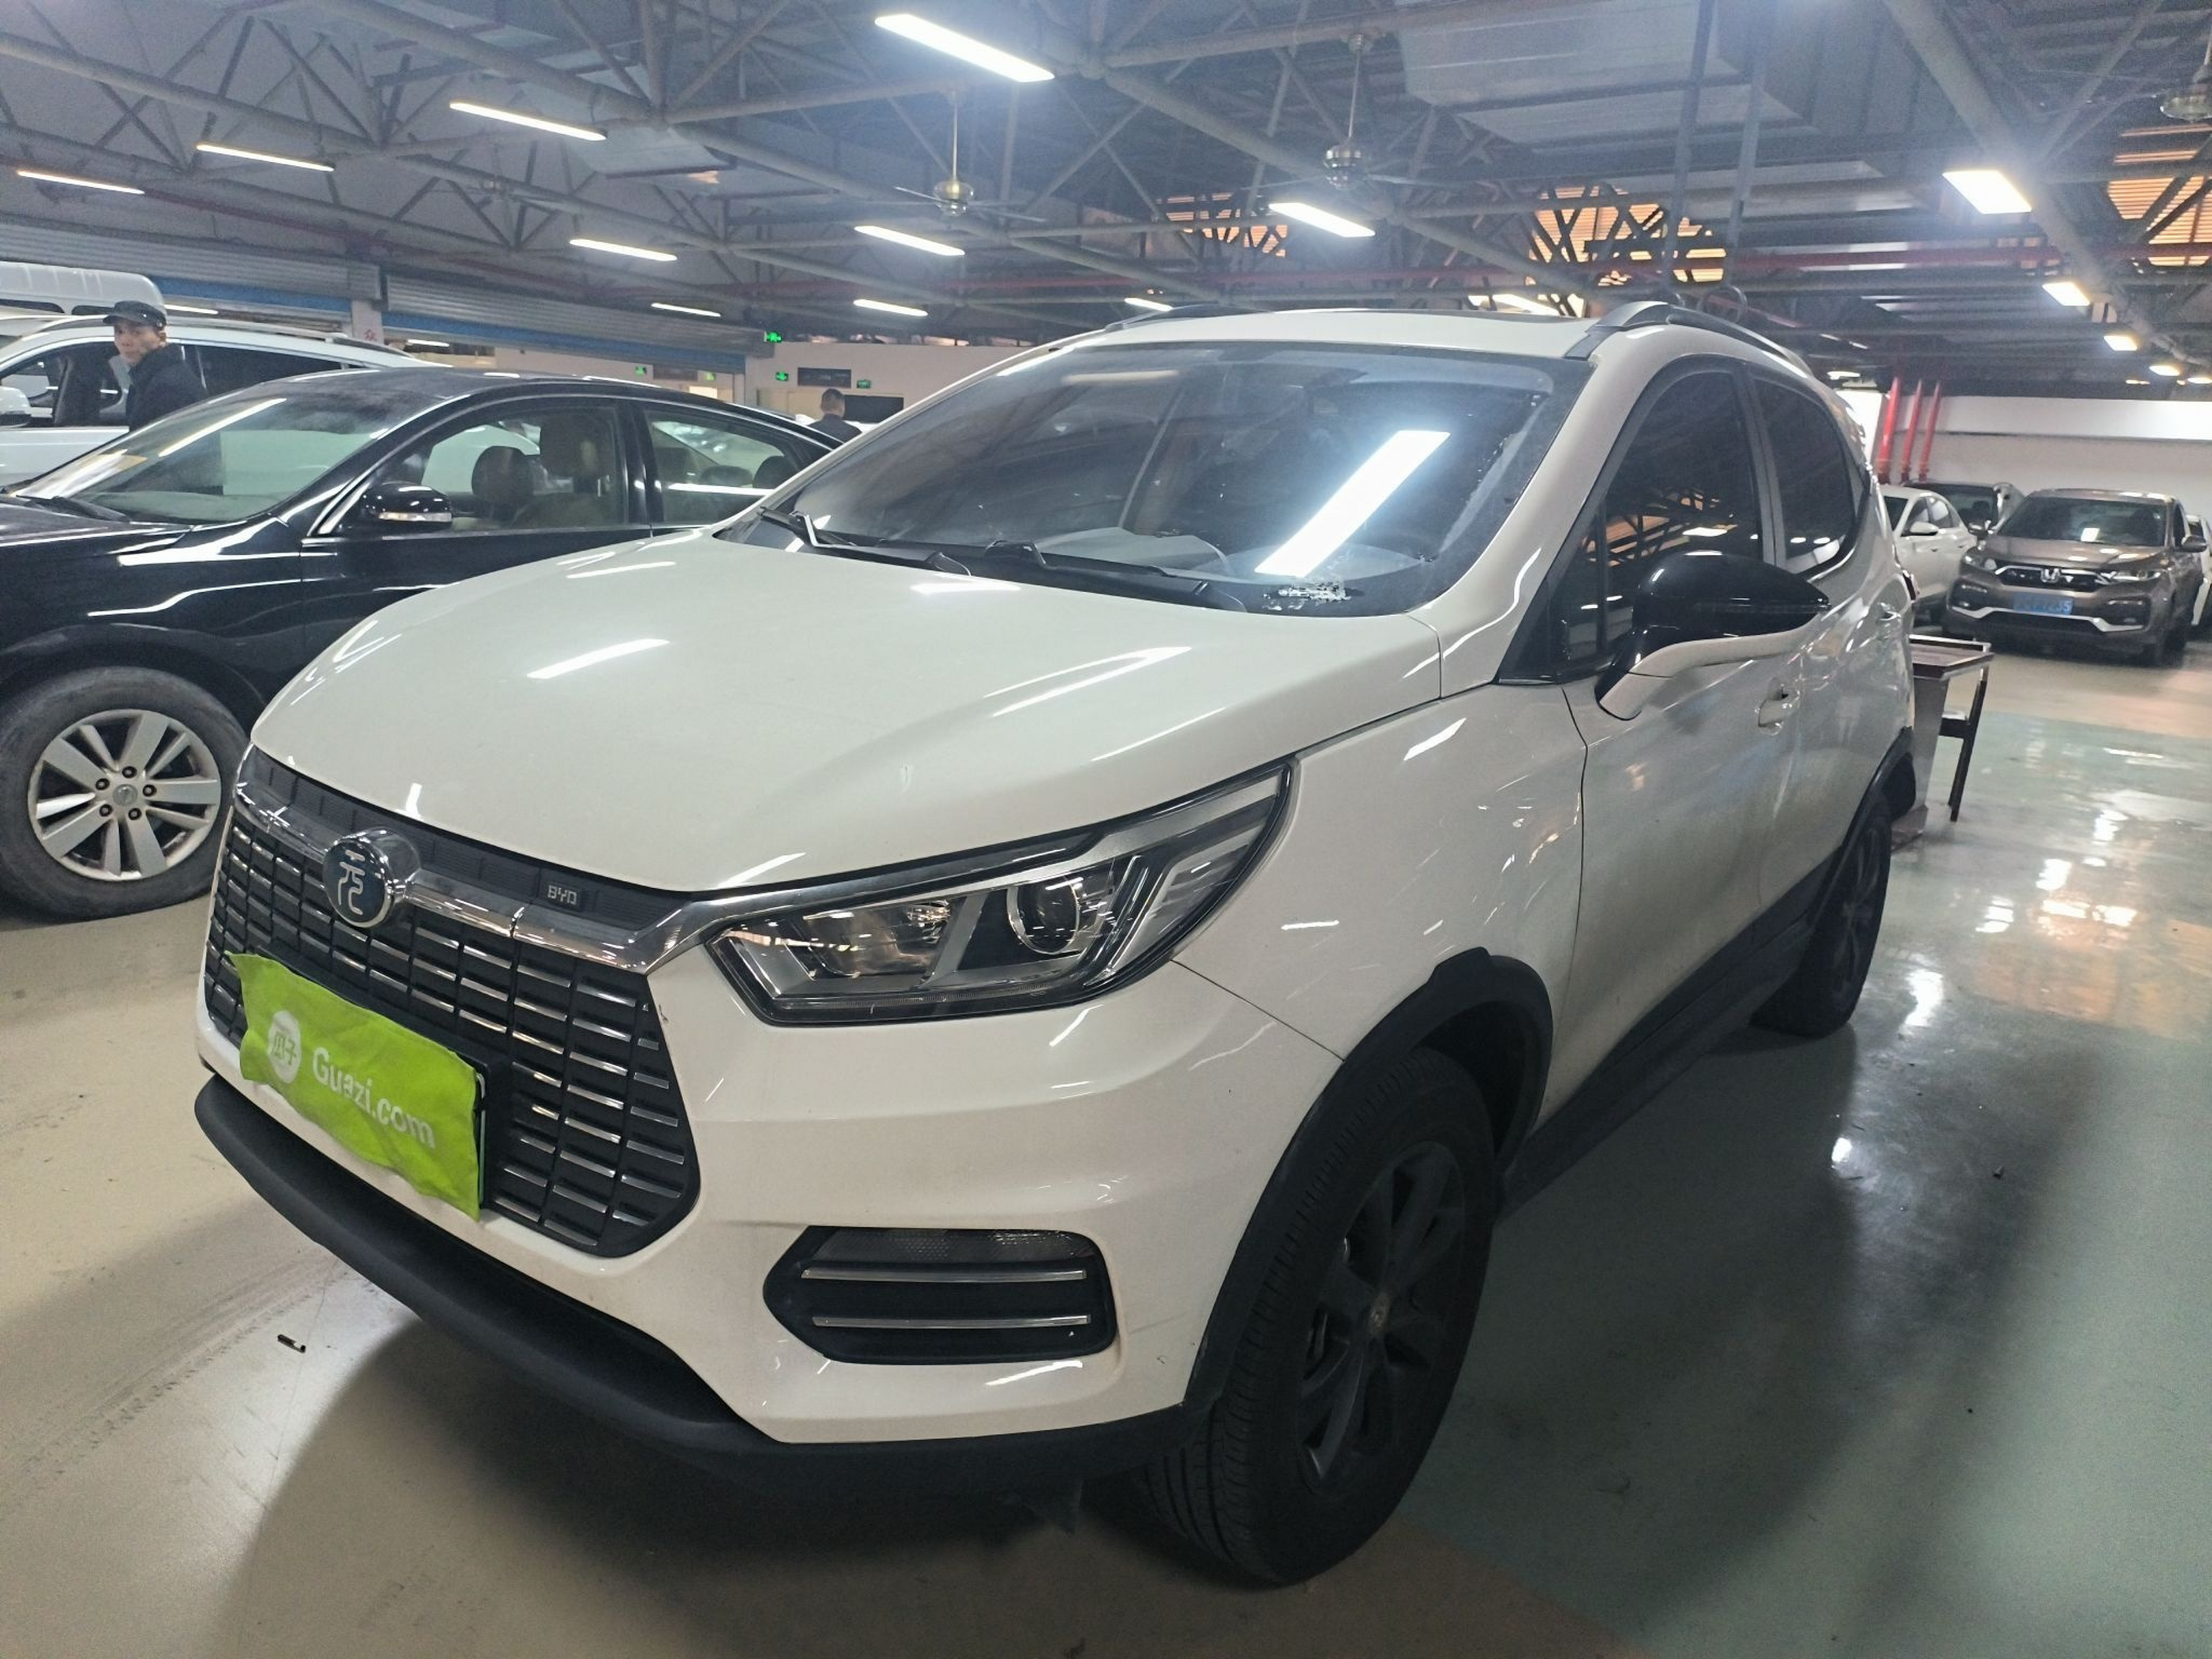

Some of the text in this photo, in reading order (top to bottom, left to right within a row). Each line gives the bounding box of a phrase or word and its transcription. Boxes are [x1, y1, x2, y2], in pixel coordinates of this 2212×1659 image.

[338, 849, 366, 915] 元
[547, 884, 577, 906] BYD
[271, 1031, 298, 1066] 瓜子
[312, 1046, 436, 1149] Guazi.com
